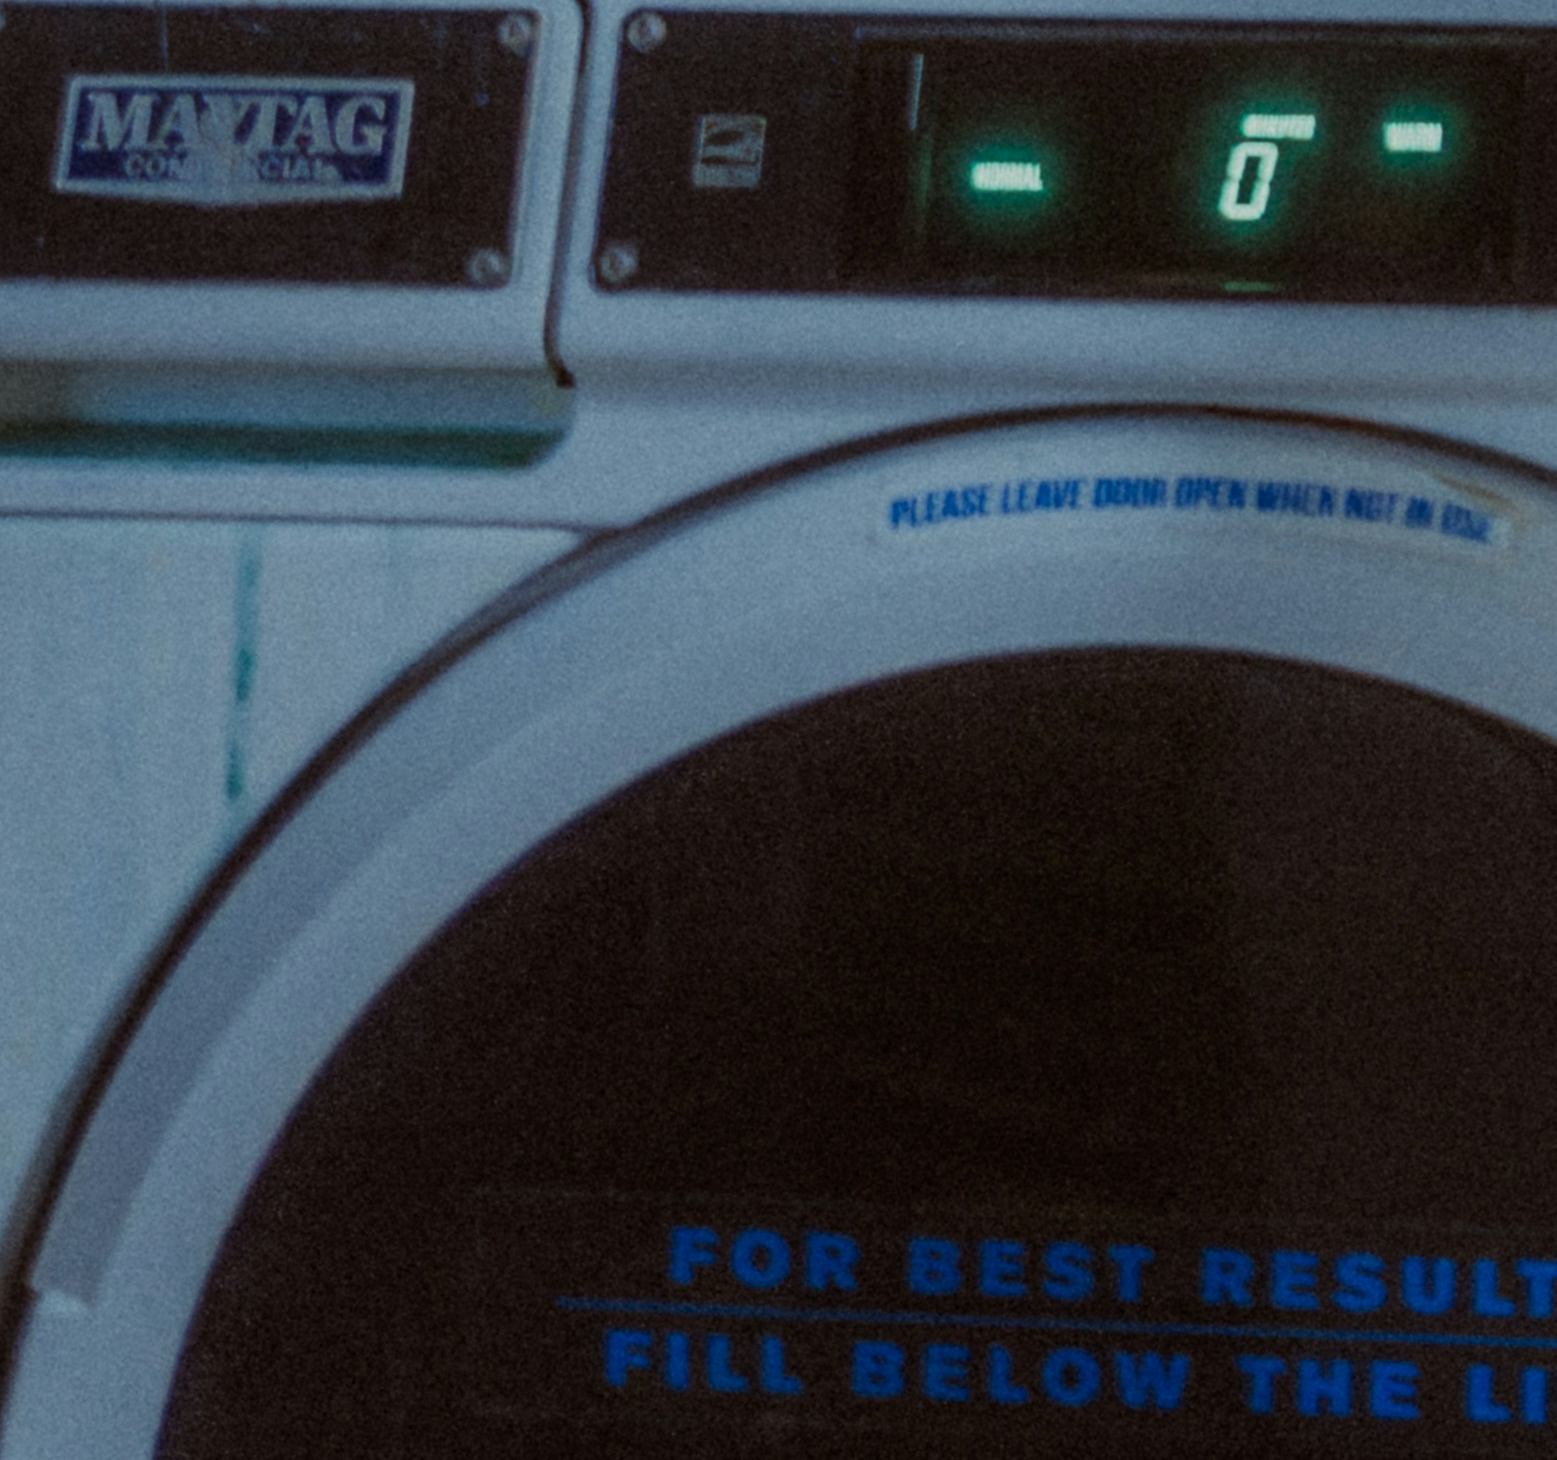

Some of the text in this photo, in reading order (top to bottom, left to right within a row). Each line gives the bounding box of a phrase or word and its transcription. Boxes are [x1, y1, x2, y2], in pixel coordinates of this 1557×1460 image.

[79, 91, 389, 157] MAYTAG
[890, 483, 990, 529] PLEASE
[668, 1226, 860, 1290] FOR
[908, 1237, 1153, 1302] BEST
[604, 1328, 802, 1394] FILL
[852, 1341, 1190, 1410] BELOW
[1237, 1354, 1420, 1421] THE
